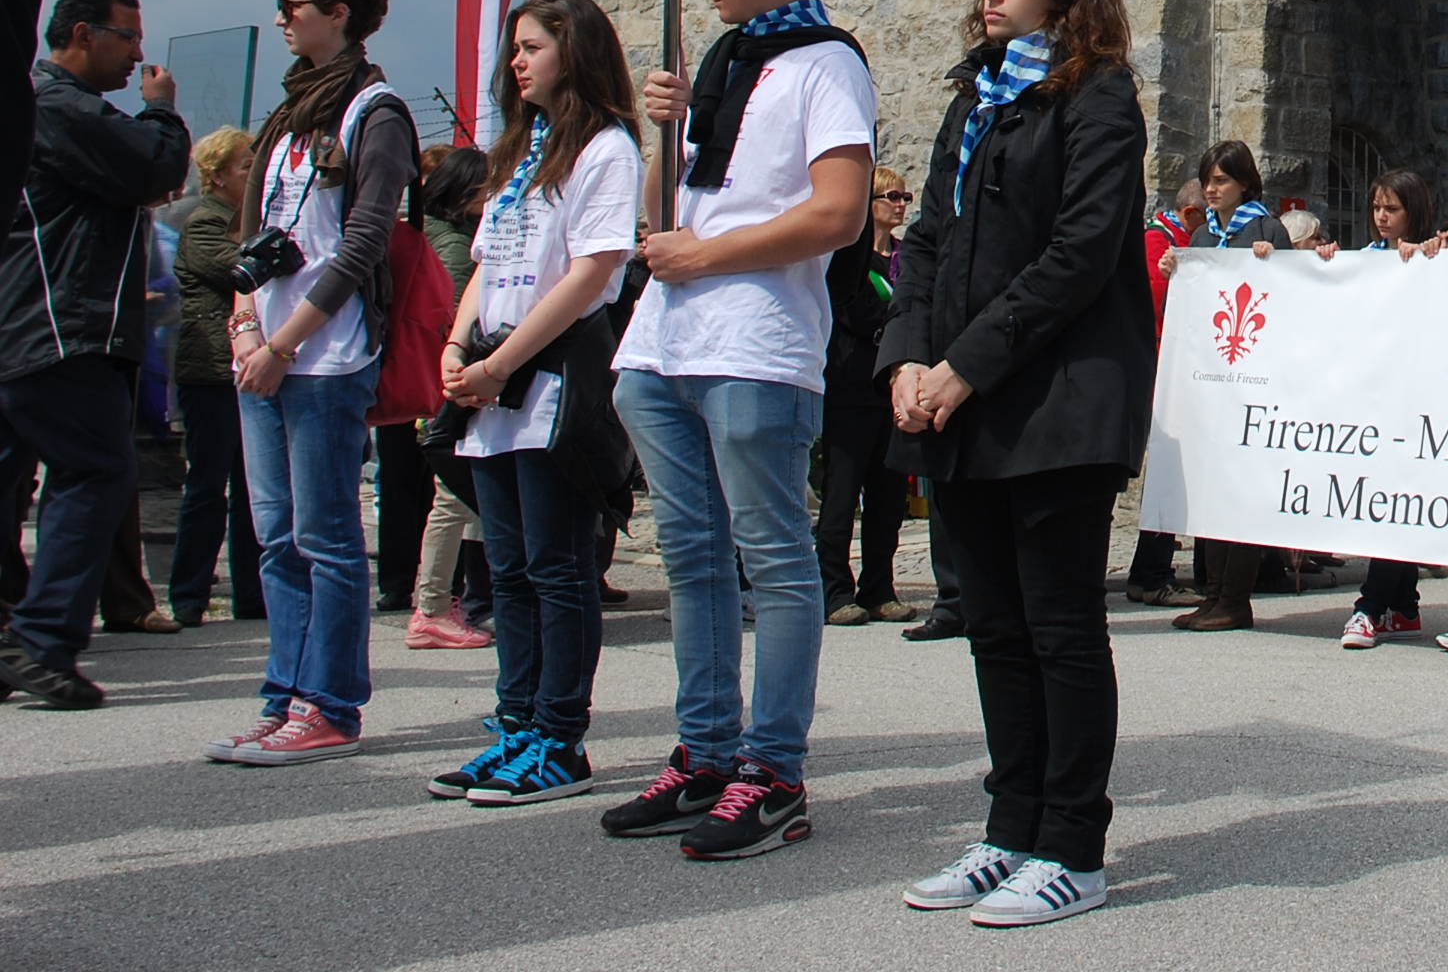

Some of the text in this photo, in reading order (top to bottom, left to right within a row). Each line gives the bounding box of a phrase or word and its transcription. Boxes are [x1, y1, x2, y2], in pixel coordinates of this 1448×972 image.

[1192, 369, 1270, 385] Comune di Firenze
[1238, 403, 1380, 457] Firenze
[1277, 469, 1311, 516] la
